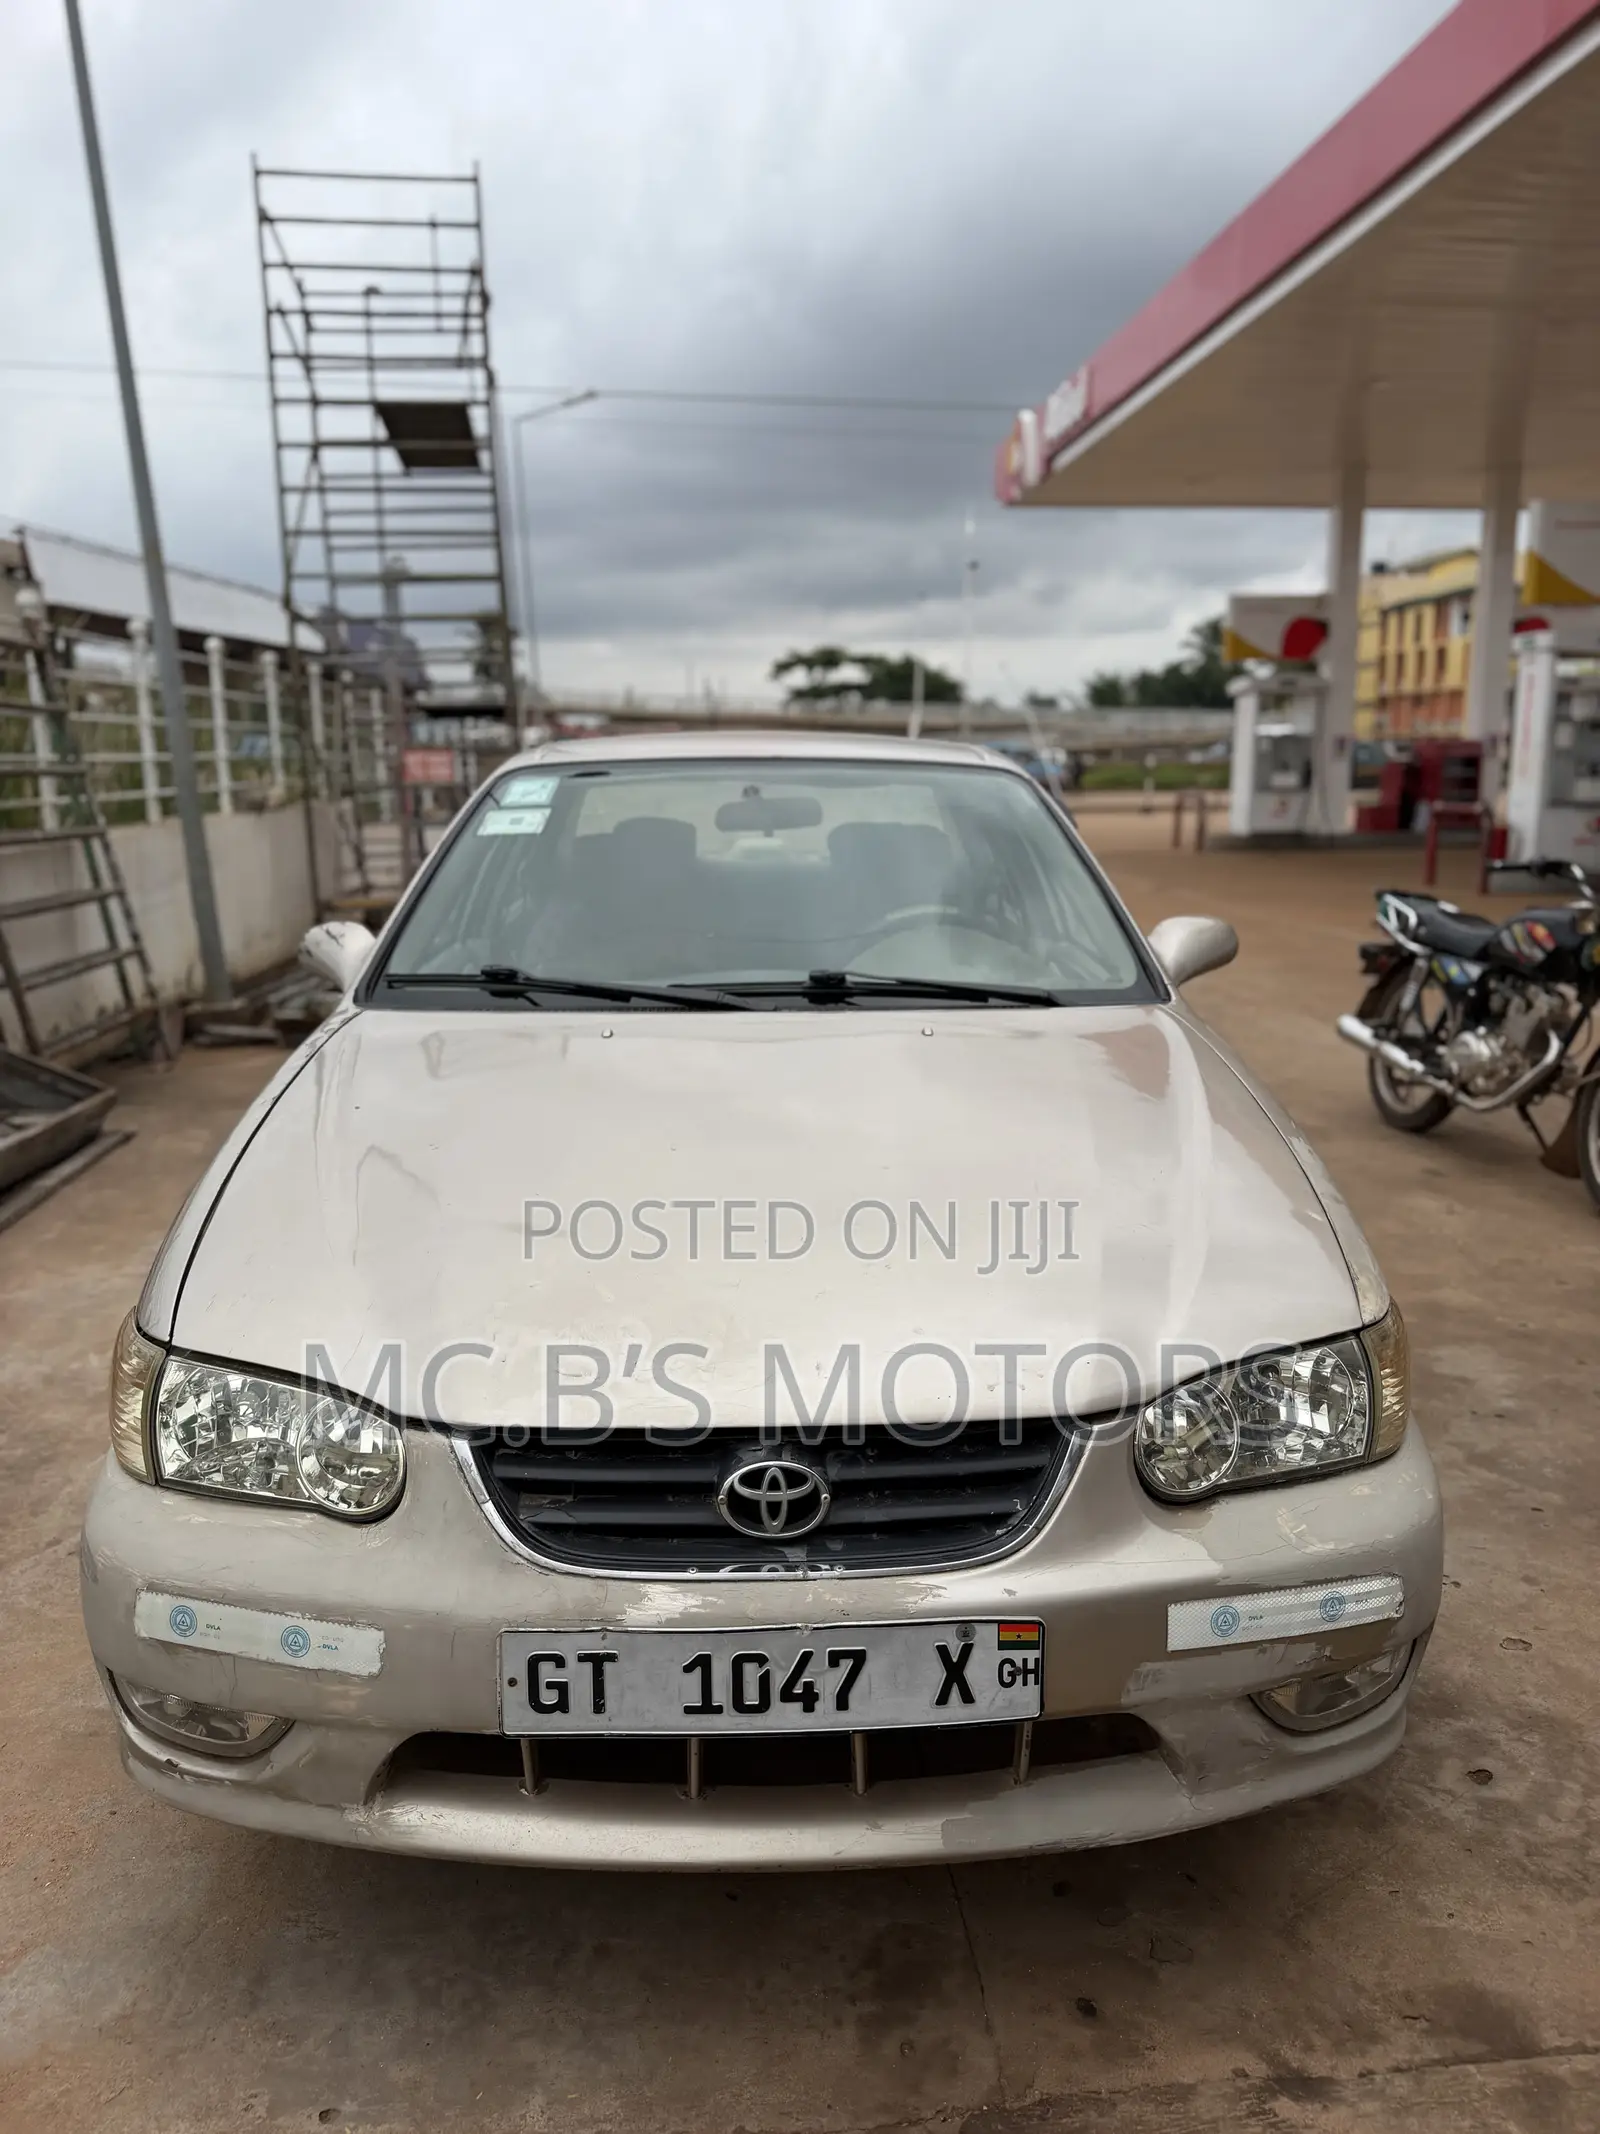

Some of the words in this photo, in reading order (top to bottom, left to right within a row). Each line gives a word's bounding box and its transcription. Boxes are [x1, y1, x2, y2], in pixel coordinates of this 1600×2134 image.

[526, 1650, 619, 1714] GT
[682, 1647, 867, 1715] 1047
[934, 1641, 977, 1705] X
[997, 1657, 1040, 1688] GH
